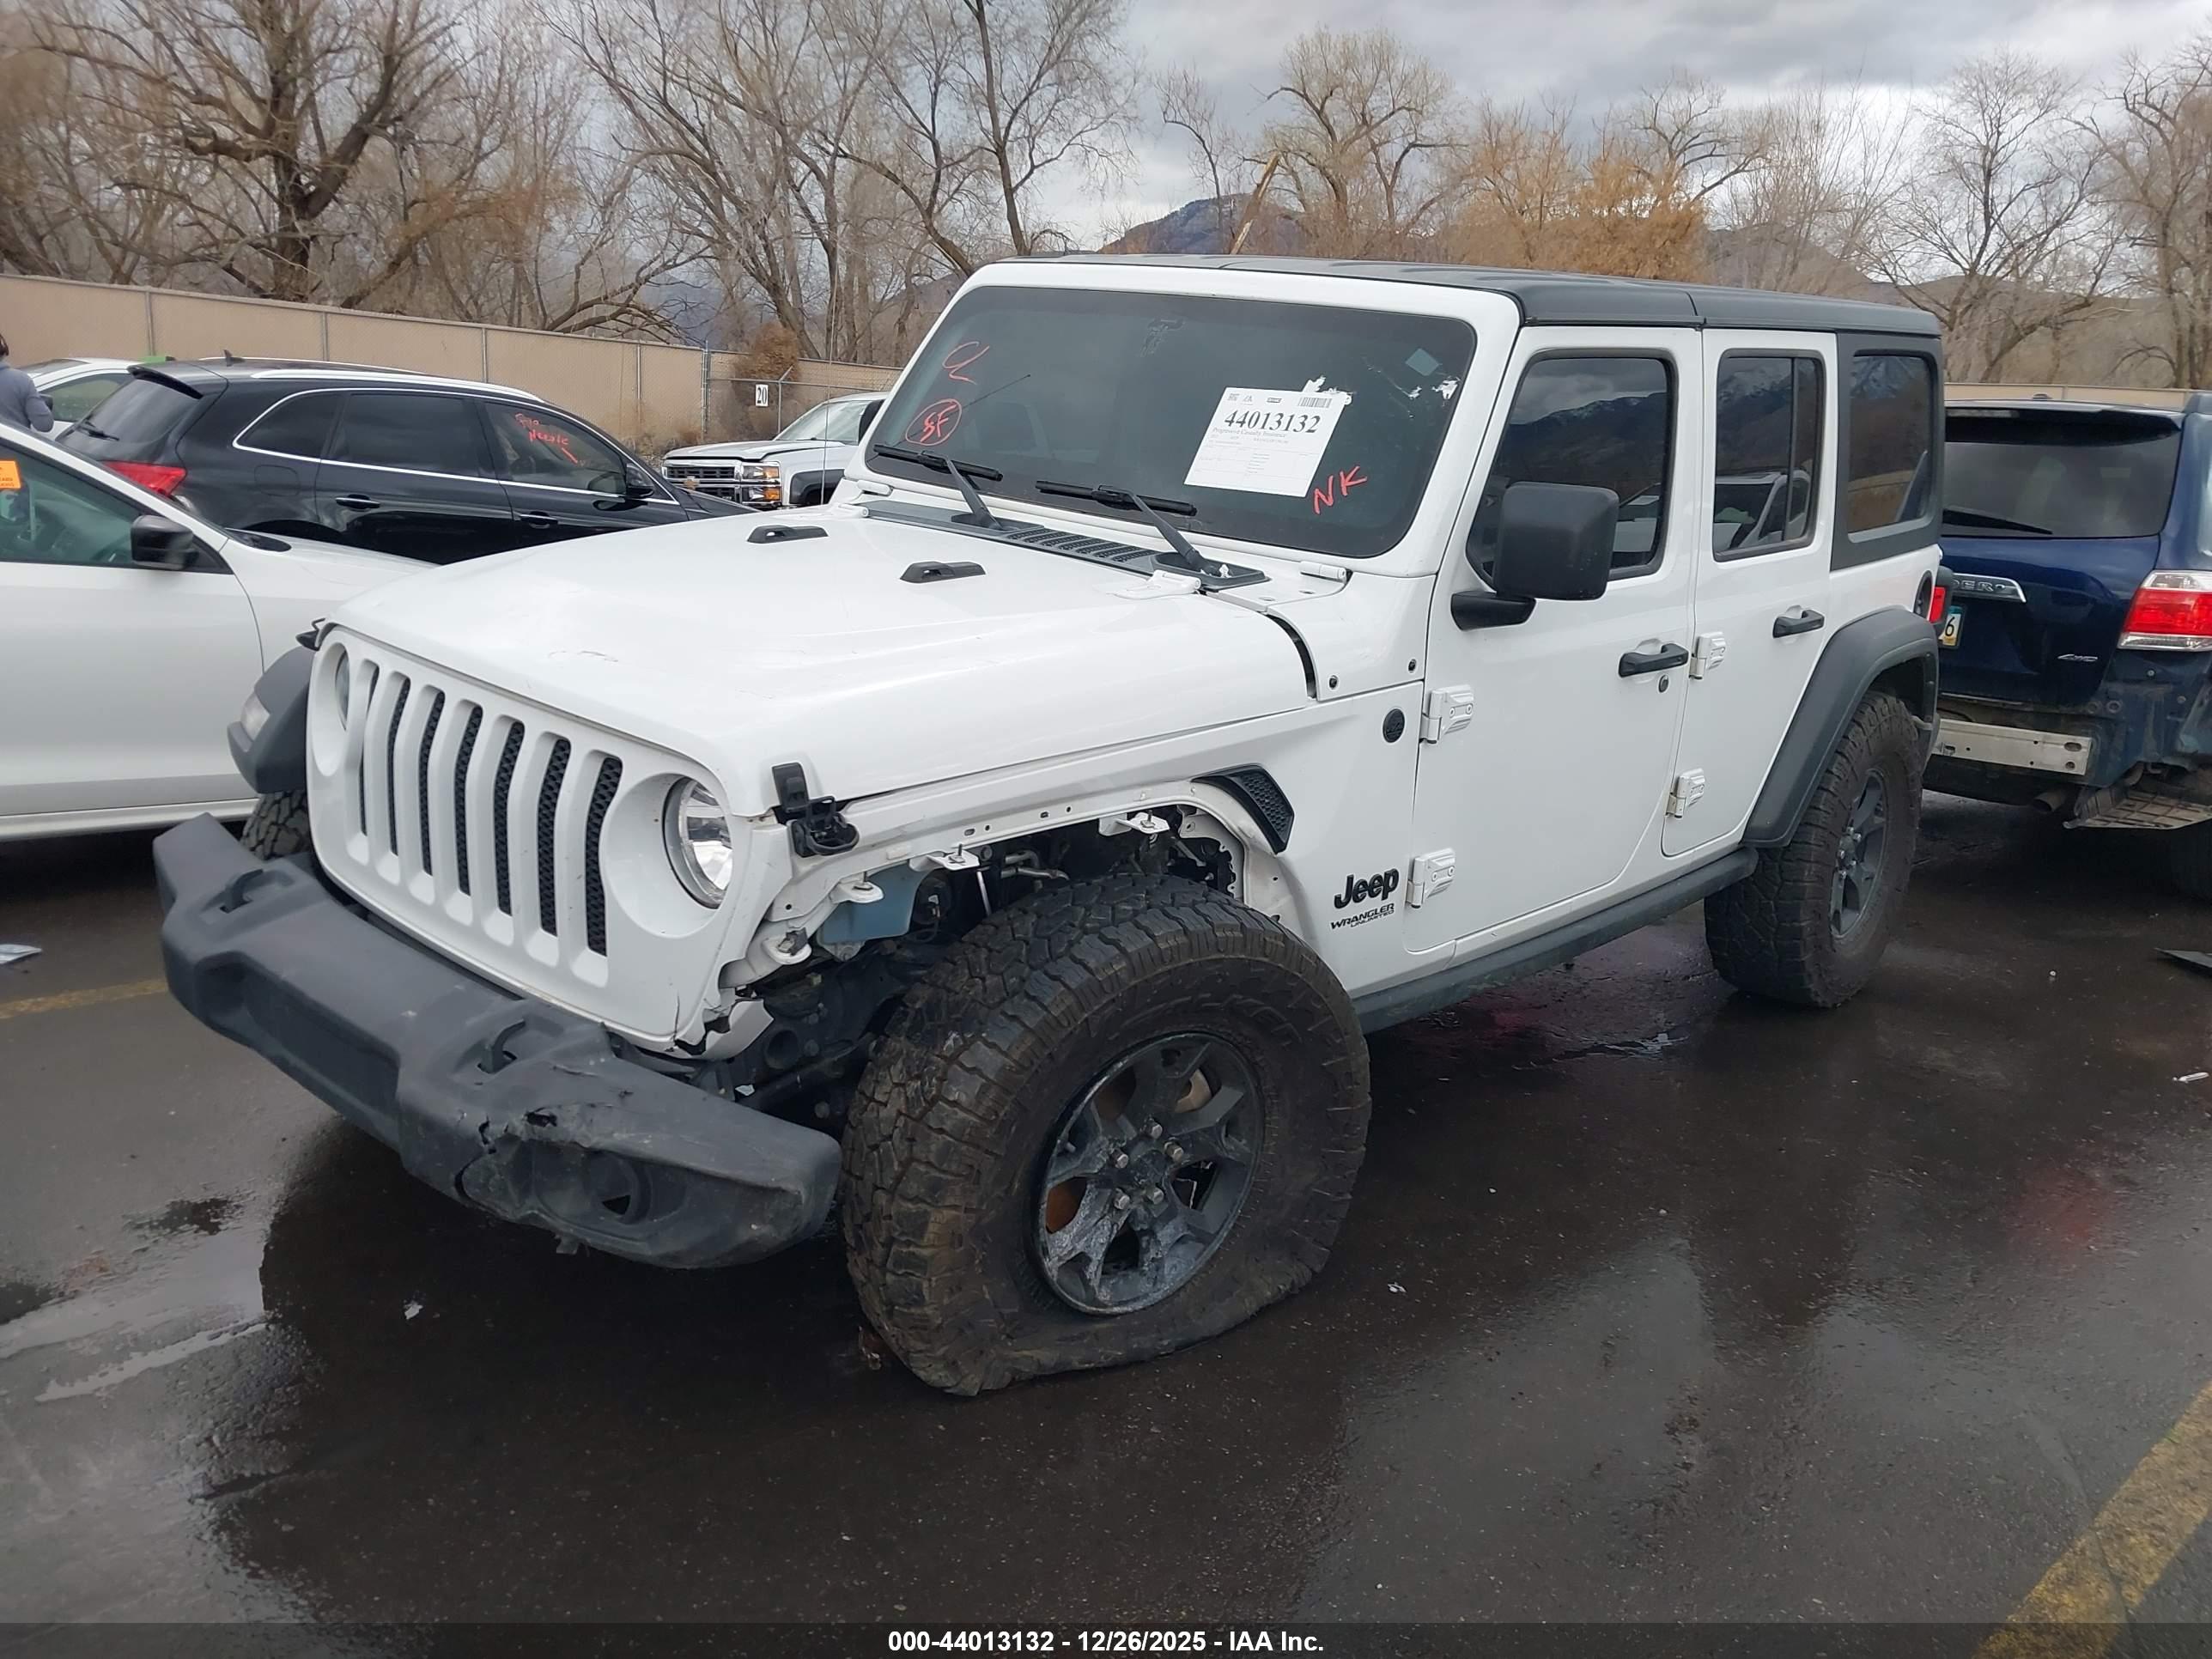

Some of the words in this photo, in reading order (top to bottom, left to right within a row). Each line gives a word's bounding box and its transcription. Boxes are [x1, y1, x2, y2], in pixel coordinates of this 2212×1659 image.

[757, 387, 768, 404] 20
[1224, 410, 1321, 433] 44013132
[1314, 465, 1368, 514] NK
[1334, 868, 1399, 909] Jeep
[1330, 902, 1395, 929] WRANGLER
[1350, 909, 1395, 927] UNLIMITED
